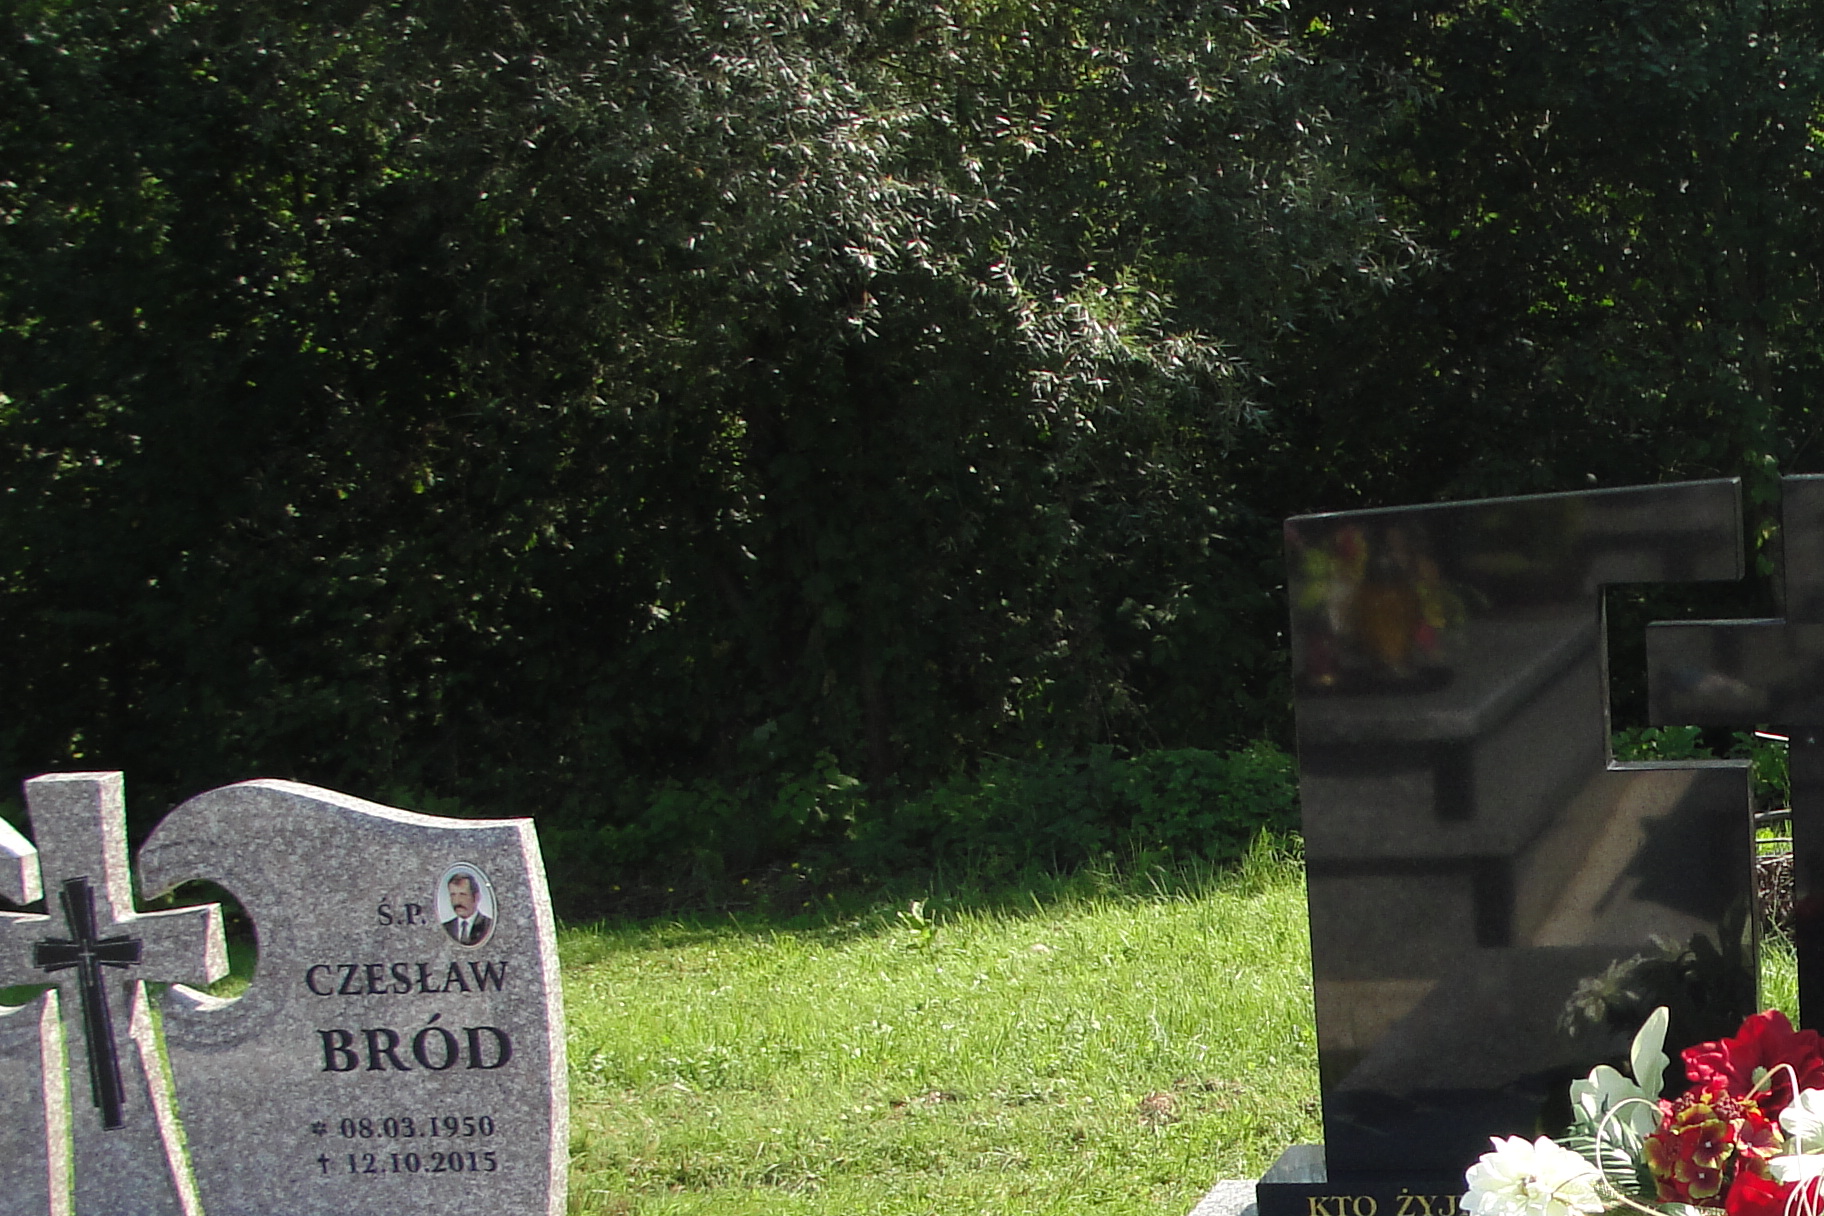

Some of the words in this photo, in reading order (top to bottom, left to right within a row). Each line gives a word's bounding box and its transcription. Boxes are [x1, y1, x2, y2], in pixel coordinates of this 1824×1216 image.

[377, 897, 427, 926] Ś.P.
[305, 961, 509, 996] CZESŁAW
[316, 1012, 514, 1073] BRÓD
[340, 1115, 495, 1138] 08.03.1950
[348, 1151, 498, 1174] 12.10.2015
